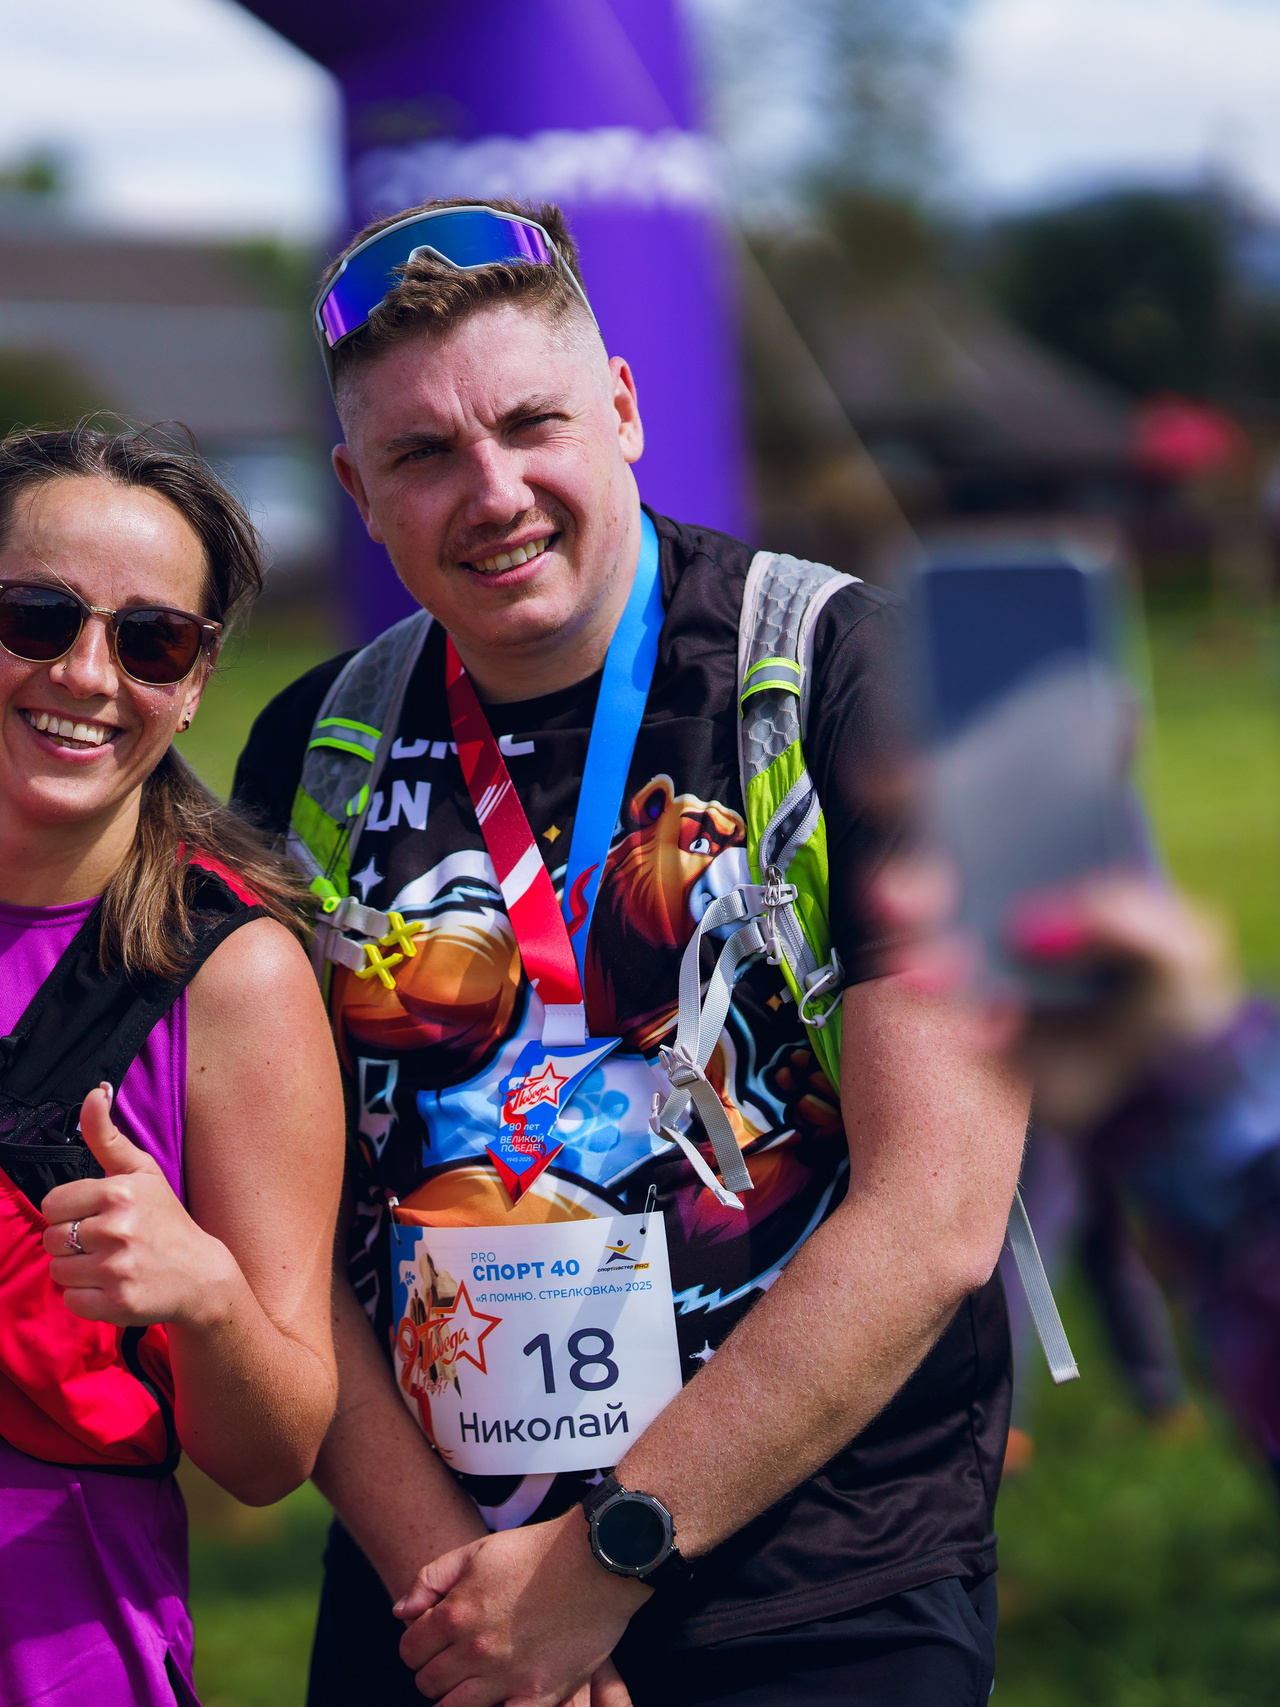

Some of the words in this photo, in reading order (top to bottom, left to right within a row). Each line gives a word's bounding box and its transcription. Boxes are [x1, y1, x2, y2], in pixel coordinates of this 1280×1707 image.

[508, 1122, 522, 1132] 80
[500, 1133, 544, 1144] ВЕЛИКОЙ
[500, 1143, 541, 1153] ПОБЕДЕ!
[470, 1251, 496, 1263] PRO
[472, 1261, 545, 1282] СПОРТ
[550, 1259, 580, 1278] 40
[634, 1262, 650, 1270] PRO
[475, 1292, 488, 1304] «Я
[489, 1291, 537, 1303] ПОМНЮ.
[538, 1283, 623, 1301] СТРЕЛКОВКА»
[625, 1280, 653, 1293] 2025
[523, 1327, 620, 1395] 18
[460, 1401, 630, 1444] Николай
